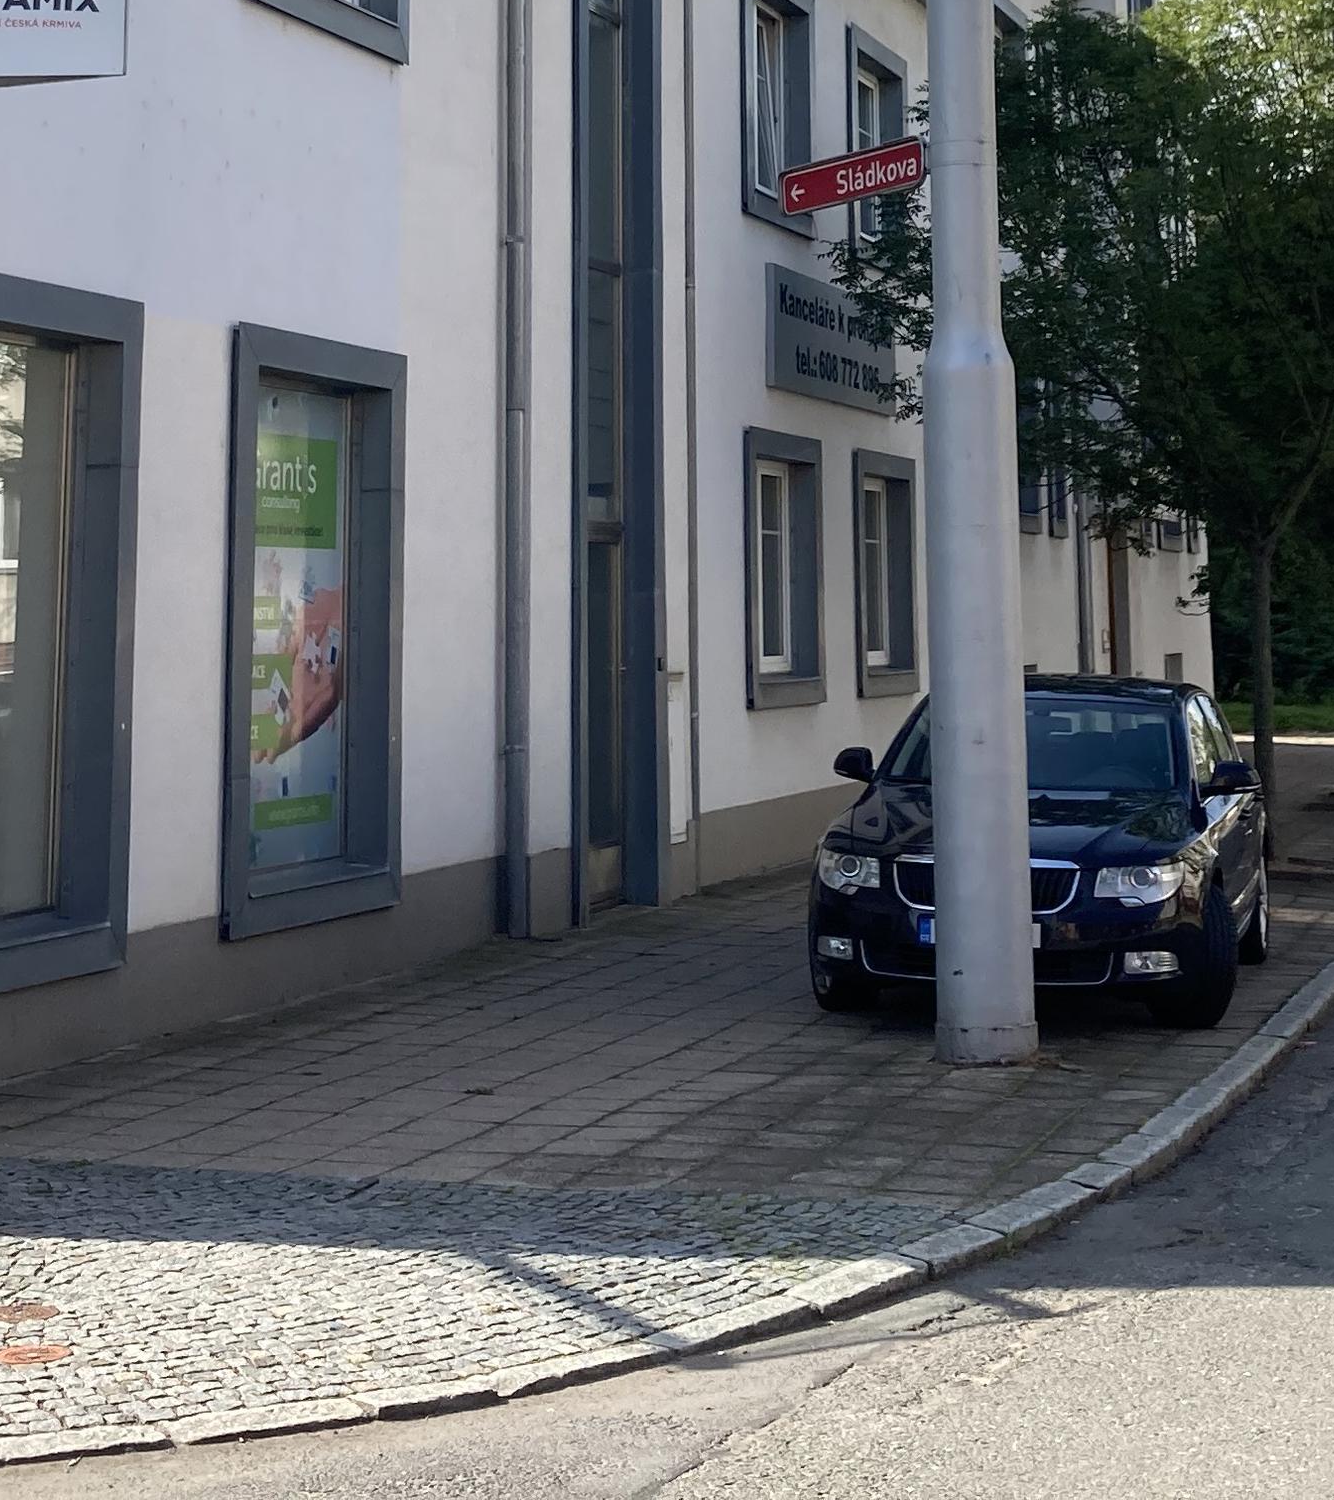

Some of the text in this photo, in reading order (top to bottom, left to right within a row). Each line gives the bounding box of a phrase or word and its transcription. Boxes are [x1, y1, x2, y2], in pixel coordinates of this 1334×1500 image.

[4, 17, 40, 28] ČESKÁ
[42, 19, 82, 29] KRMIVA
[836, 157, 917, 195] Sládkova
[838, 304, 845, 334] k
[819, 349, 838, 384] 608
[841, 357, 860, 390] 772
